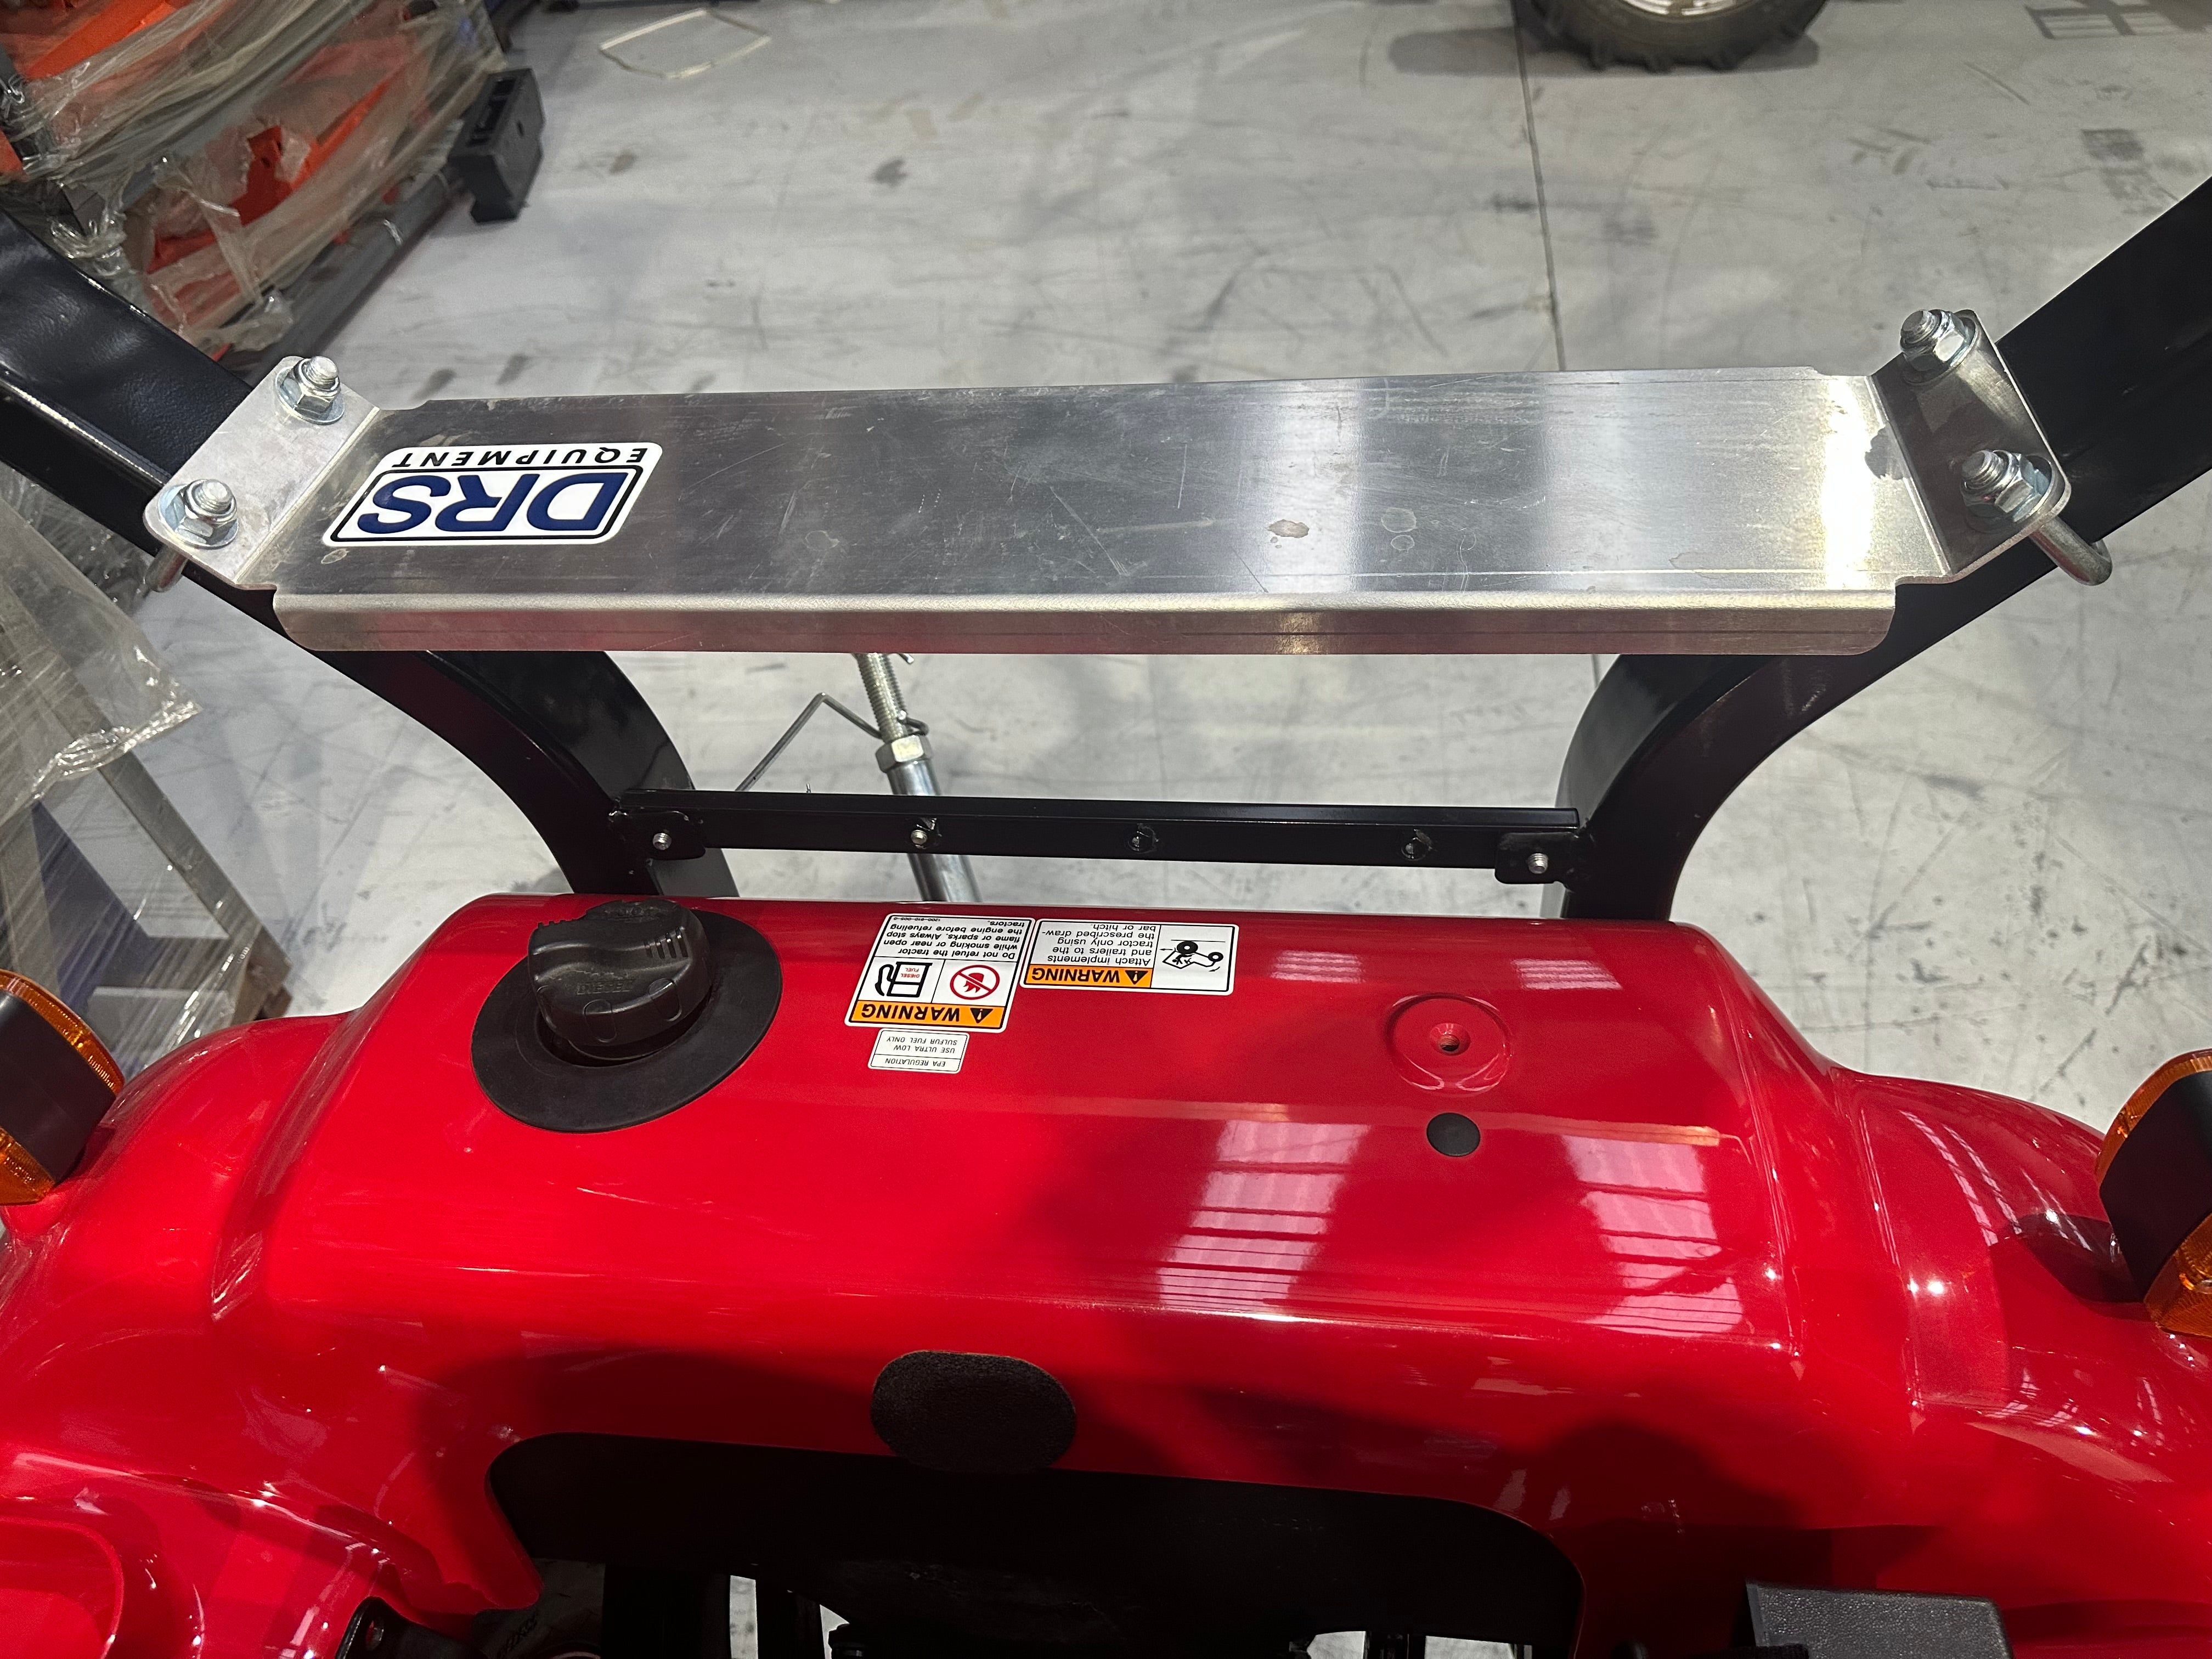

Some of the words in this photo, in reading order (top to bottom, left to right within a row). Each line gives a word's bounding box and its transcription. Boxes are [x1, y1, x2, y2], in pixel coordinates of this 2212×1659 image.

[391, 448, 647, 467] EQUIPMENT
[357, 472, 628, 535] DRS
[890, 924, 932, 932] refueling
[1058, 937, 1086, 946] using
[1091, 938, 1113, 946] only
[952, 950, 979, 958] refuel
[1048, 955, 1110, 964] implements
[1115, 958, 1150, 966] Attach
[1032, 968, 1120, 983] WARNING
[861, 1004, 960, 1022] WARNING
